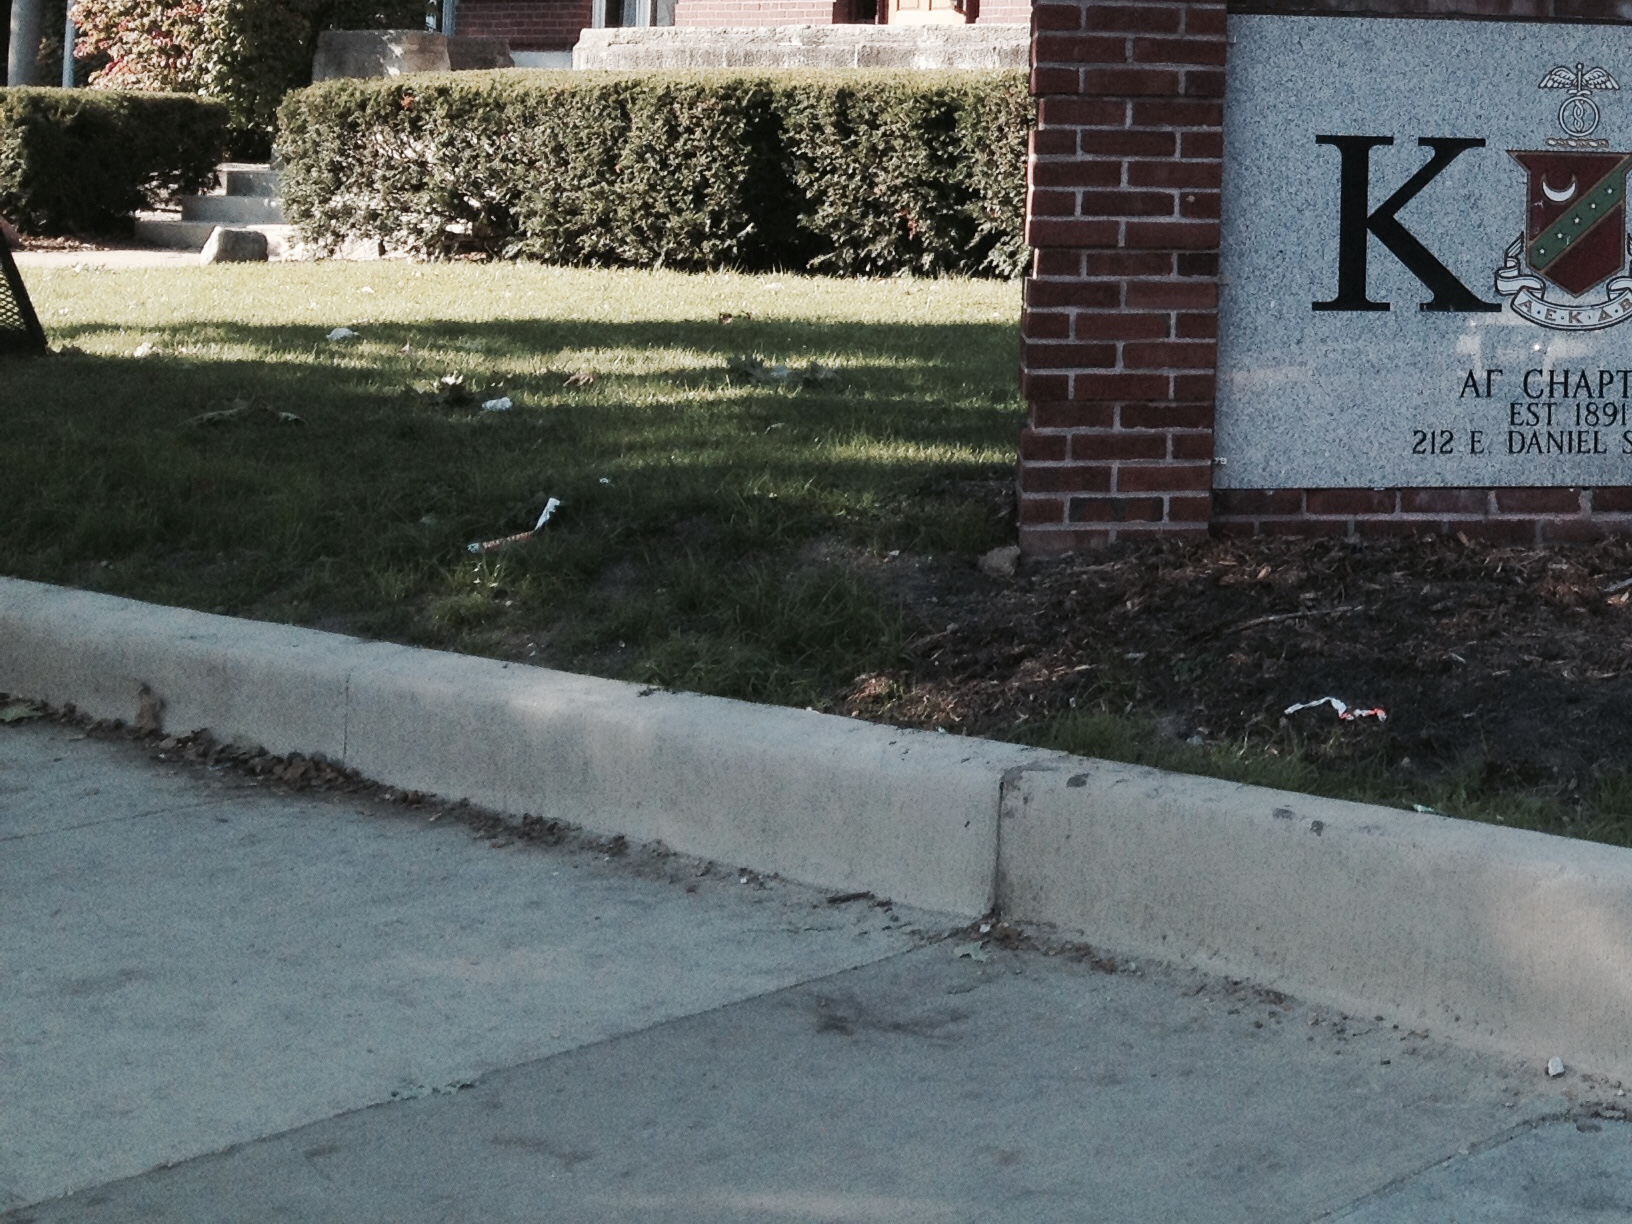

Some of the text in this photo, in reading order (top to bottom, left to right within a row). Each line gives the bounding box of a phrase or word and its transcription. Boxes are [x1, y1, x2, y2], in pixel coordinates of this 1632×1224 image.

[1509, 402, 1627, 427] EST 1891
[1412, 430, 1454, 455] 212
[1507, 430, 1608, 455] DANIEL
